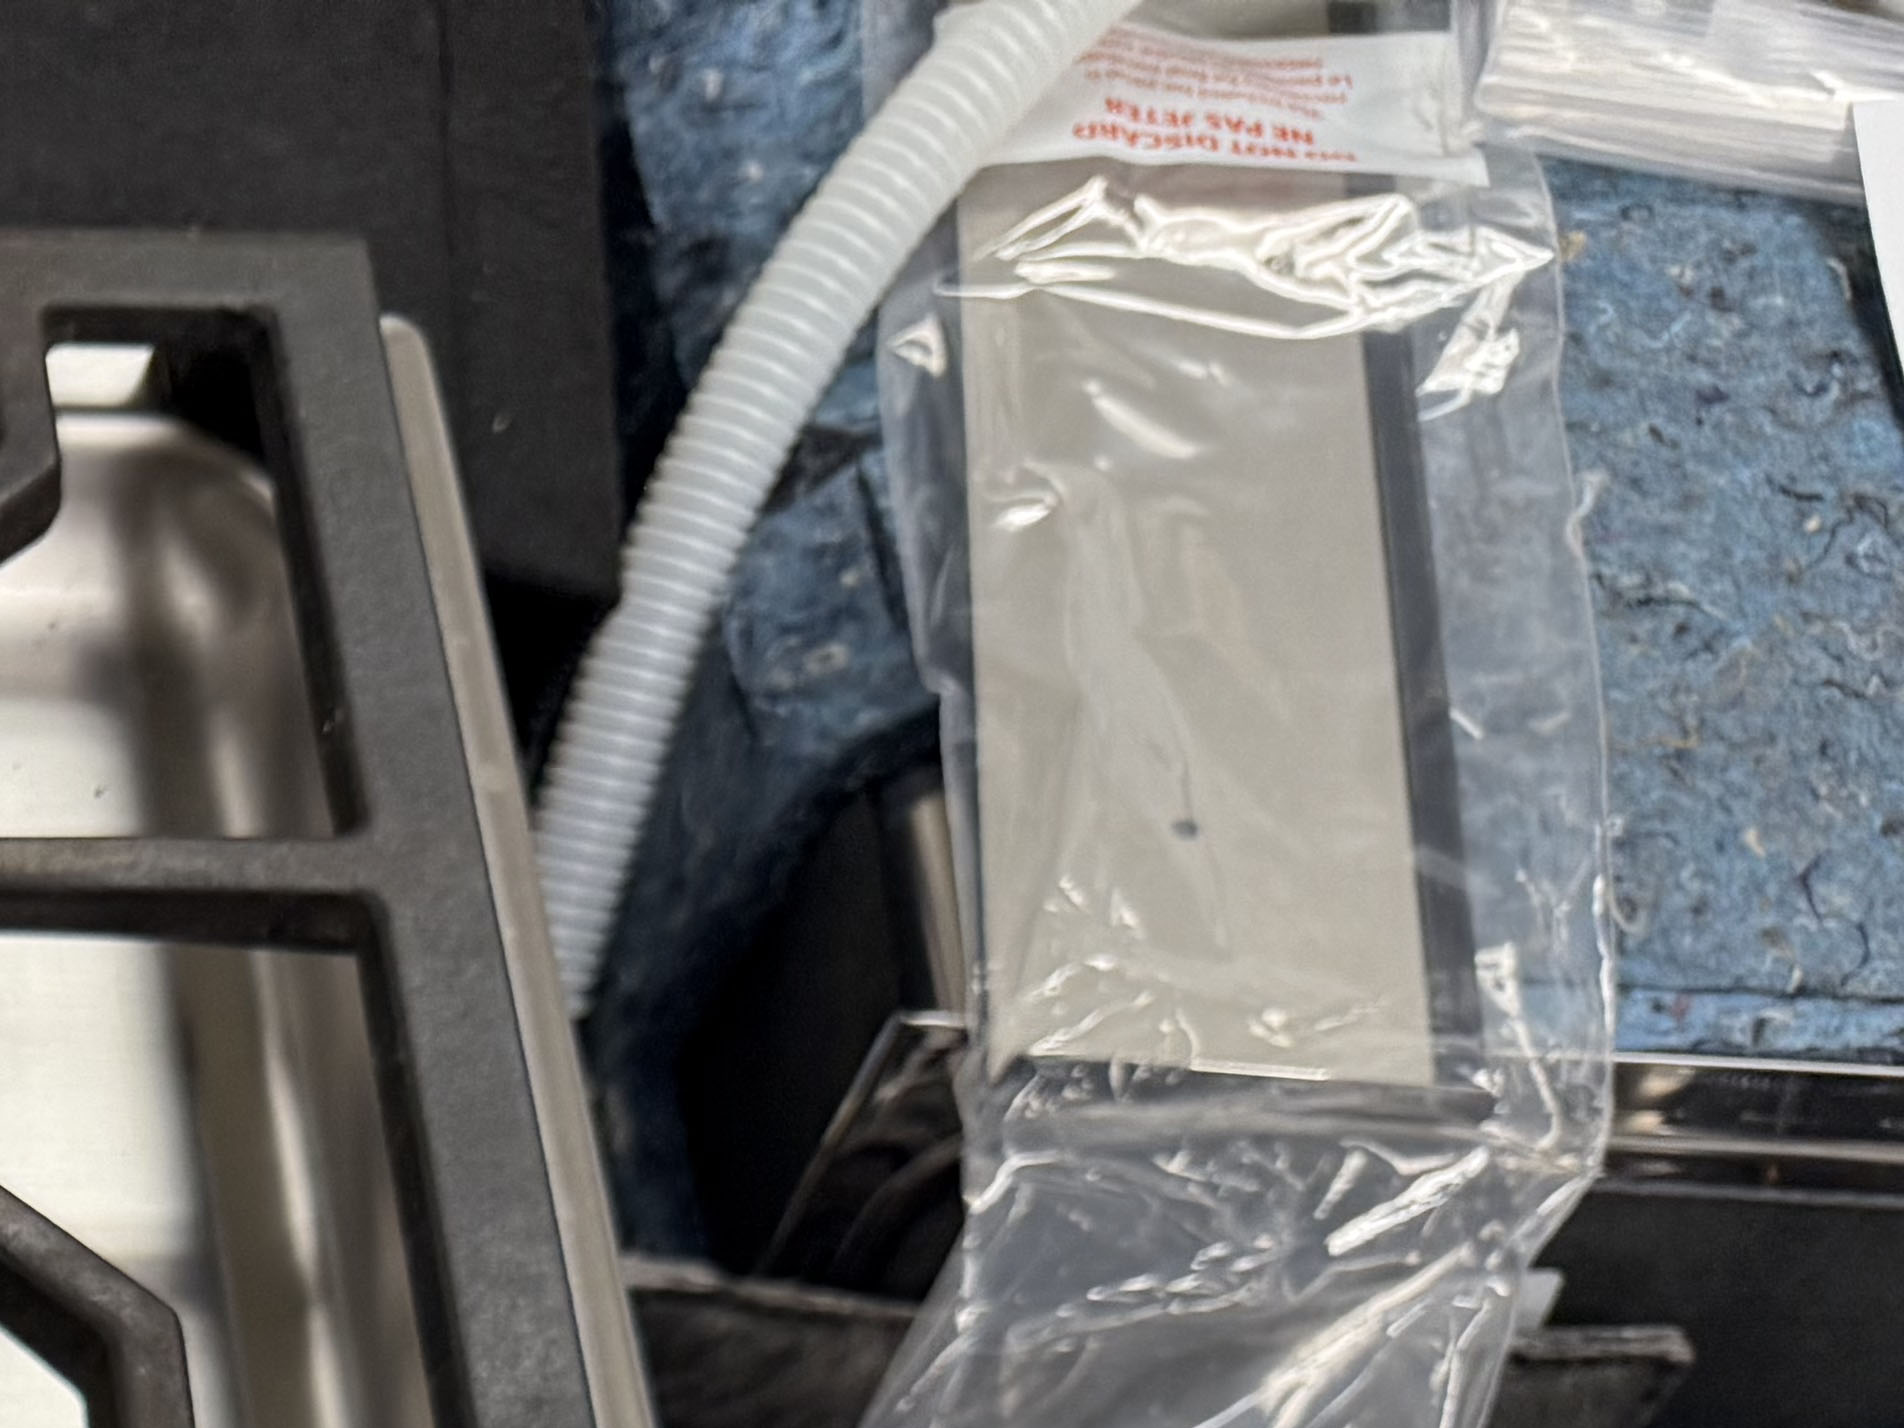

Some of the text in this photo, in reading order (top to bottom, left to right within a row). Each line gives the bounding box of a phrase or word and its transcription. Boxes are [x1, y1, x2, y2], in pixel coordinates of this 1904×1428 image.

[1104, 97, 1315, 146] NE PAS JETER
